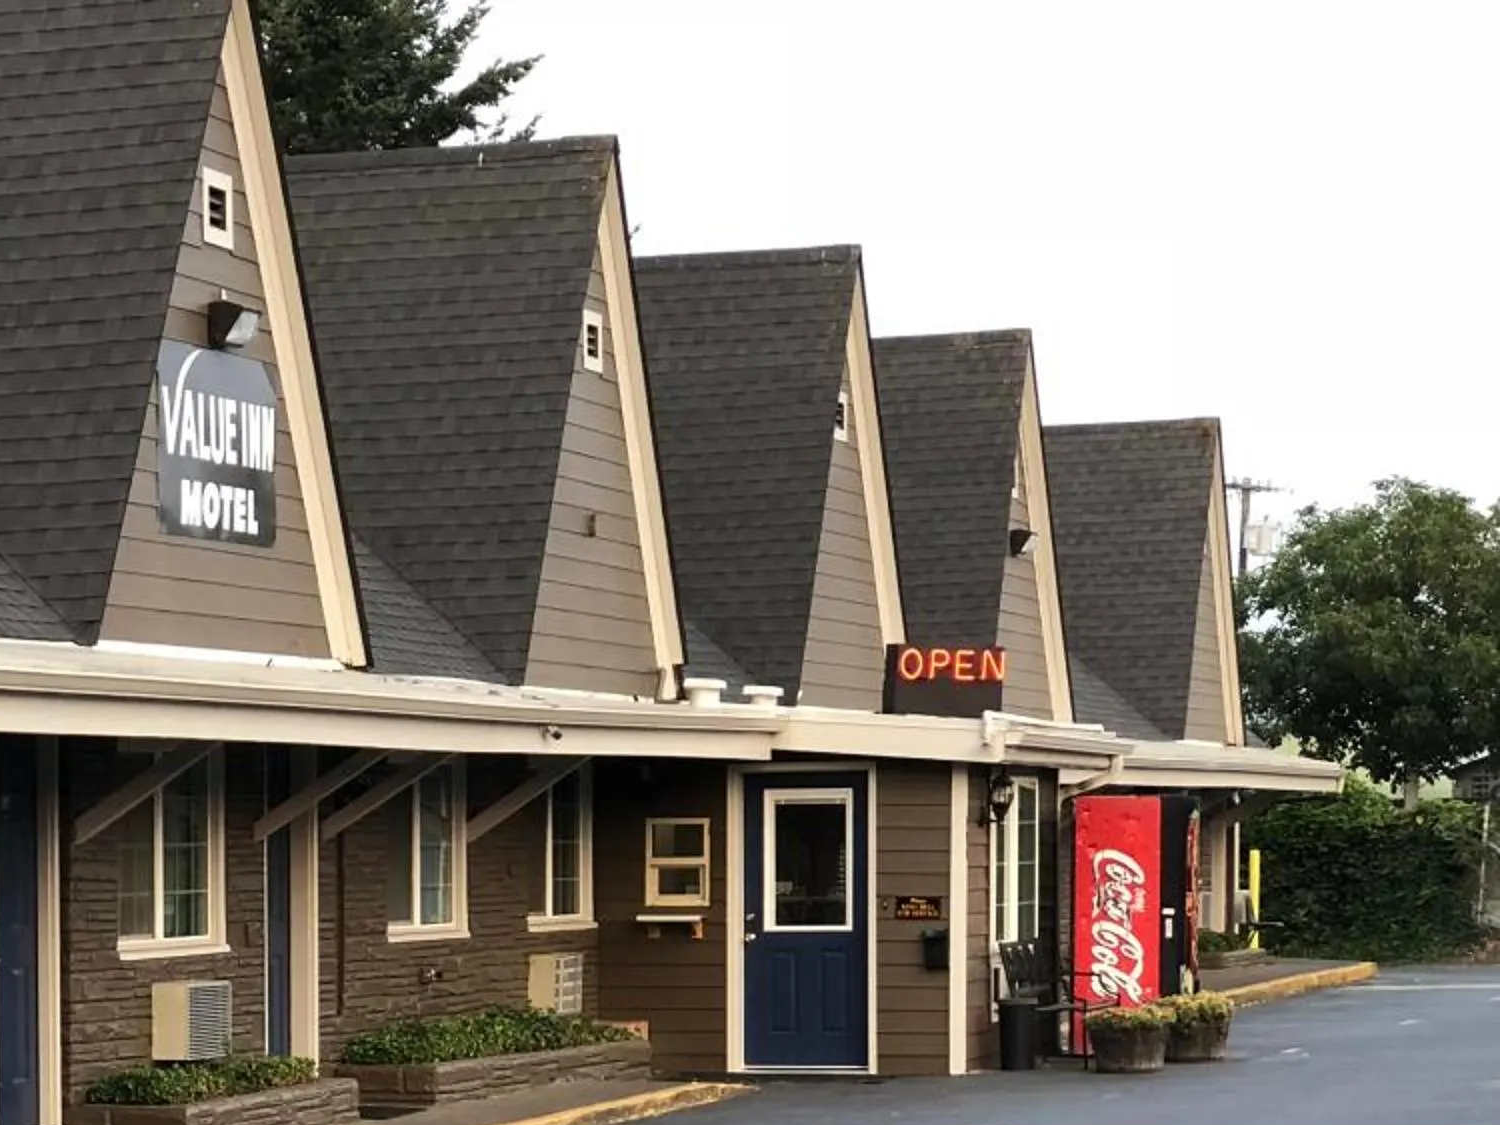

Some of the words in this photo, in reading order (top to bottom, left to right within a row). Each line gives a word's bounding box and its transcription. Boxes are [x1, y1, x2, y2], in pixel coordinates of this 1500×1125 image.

[162, 350, 237, 465] VALUE
[241, 401, 275, 472] INN
[180, 479, 259, 535] MOTEL
[900, 647, 1007, 681] OPEN
